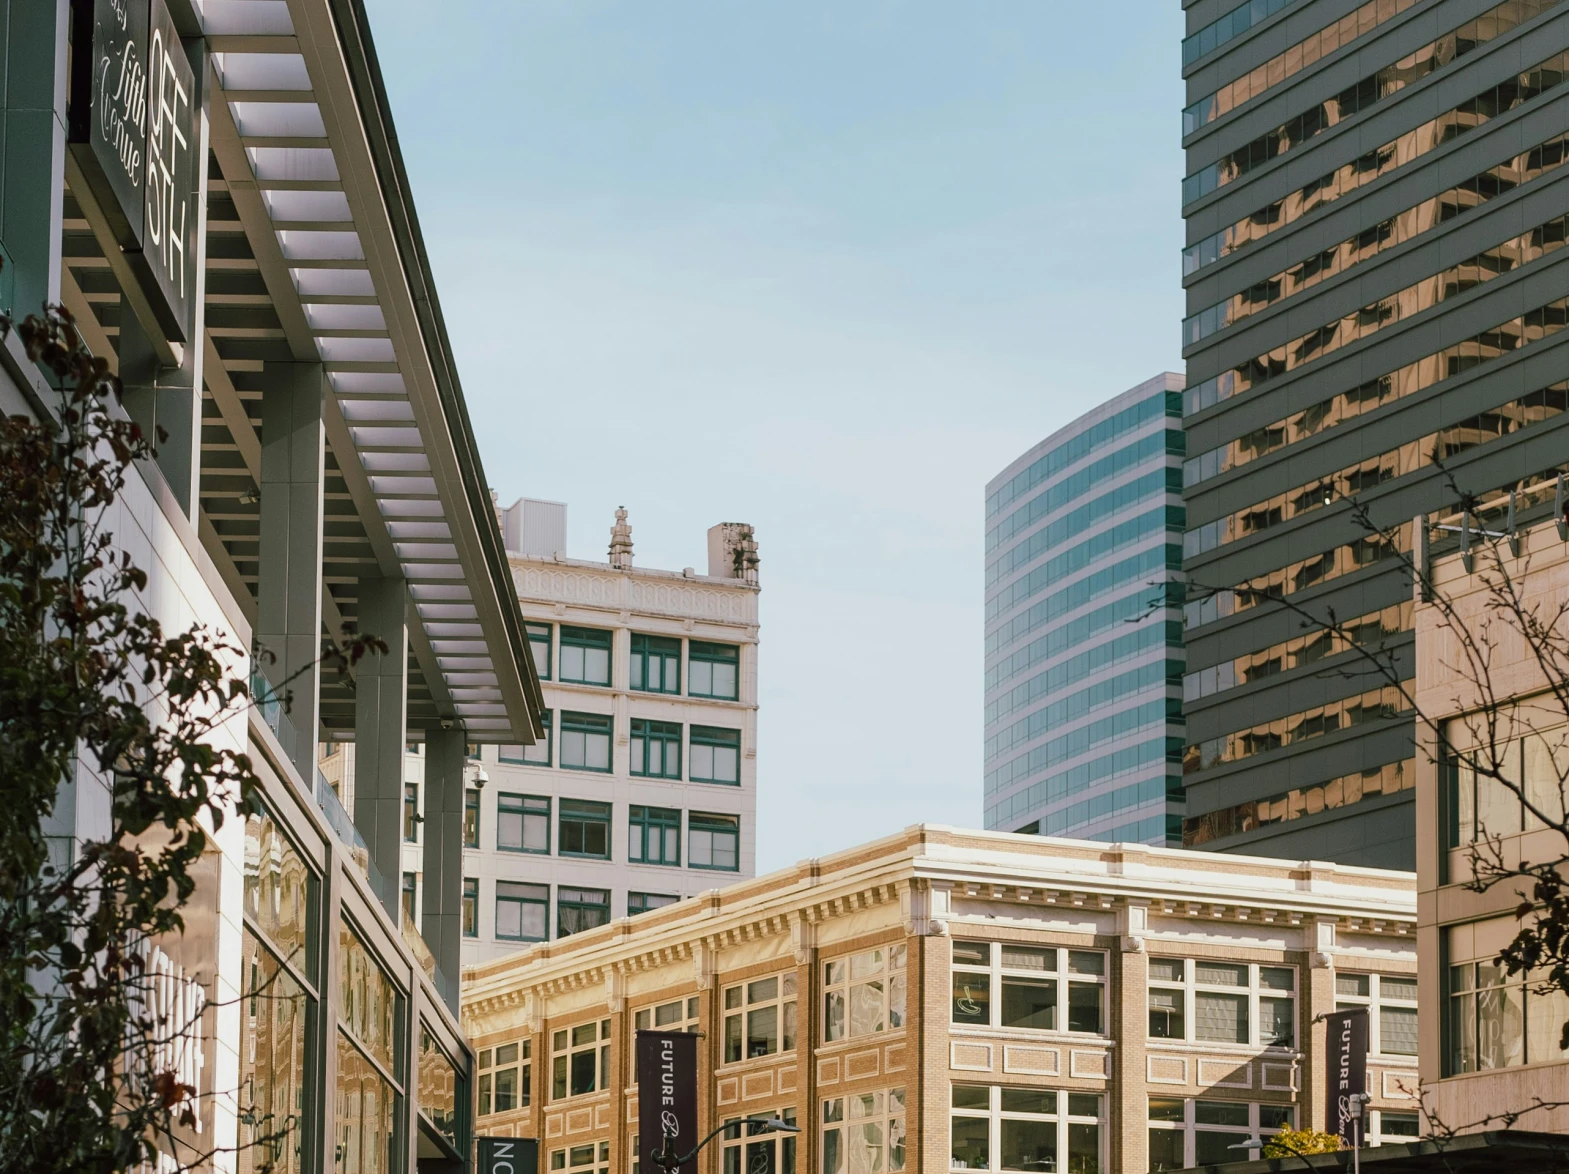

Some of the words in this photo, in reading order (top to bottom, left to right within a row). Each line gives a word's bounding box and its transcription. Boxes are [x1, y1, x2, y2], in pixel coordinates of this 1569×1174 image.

[90, 56, 140, 187] Avenue
[110, 40, 146, 139] Fifth
[150, 28, 188, 175] OFF
[148, 131, 186, 299] 5TH
[661, 1040, 674, 1106] FUTURE
[1339, 1019, 1352, 1090] FUTURE
